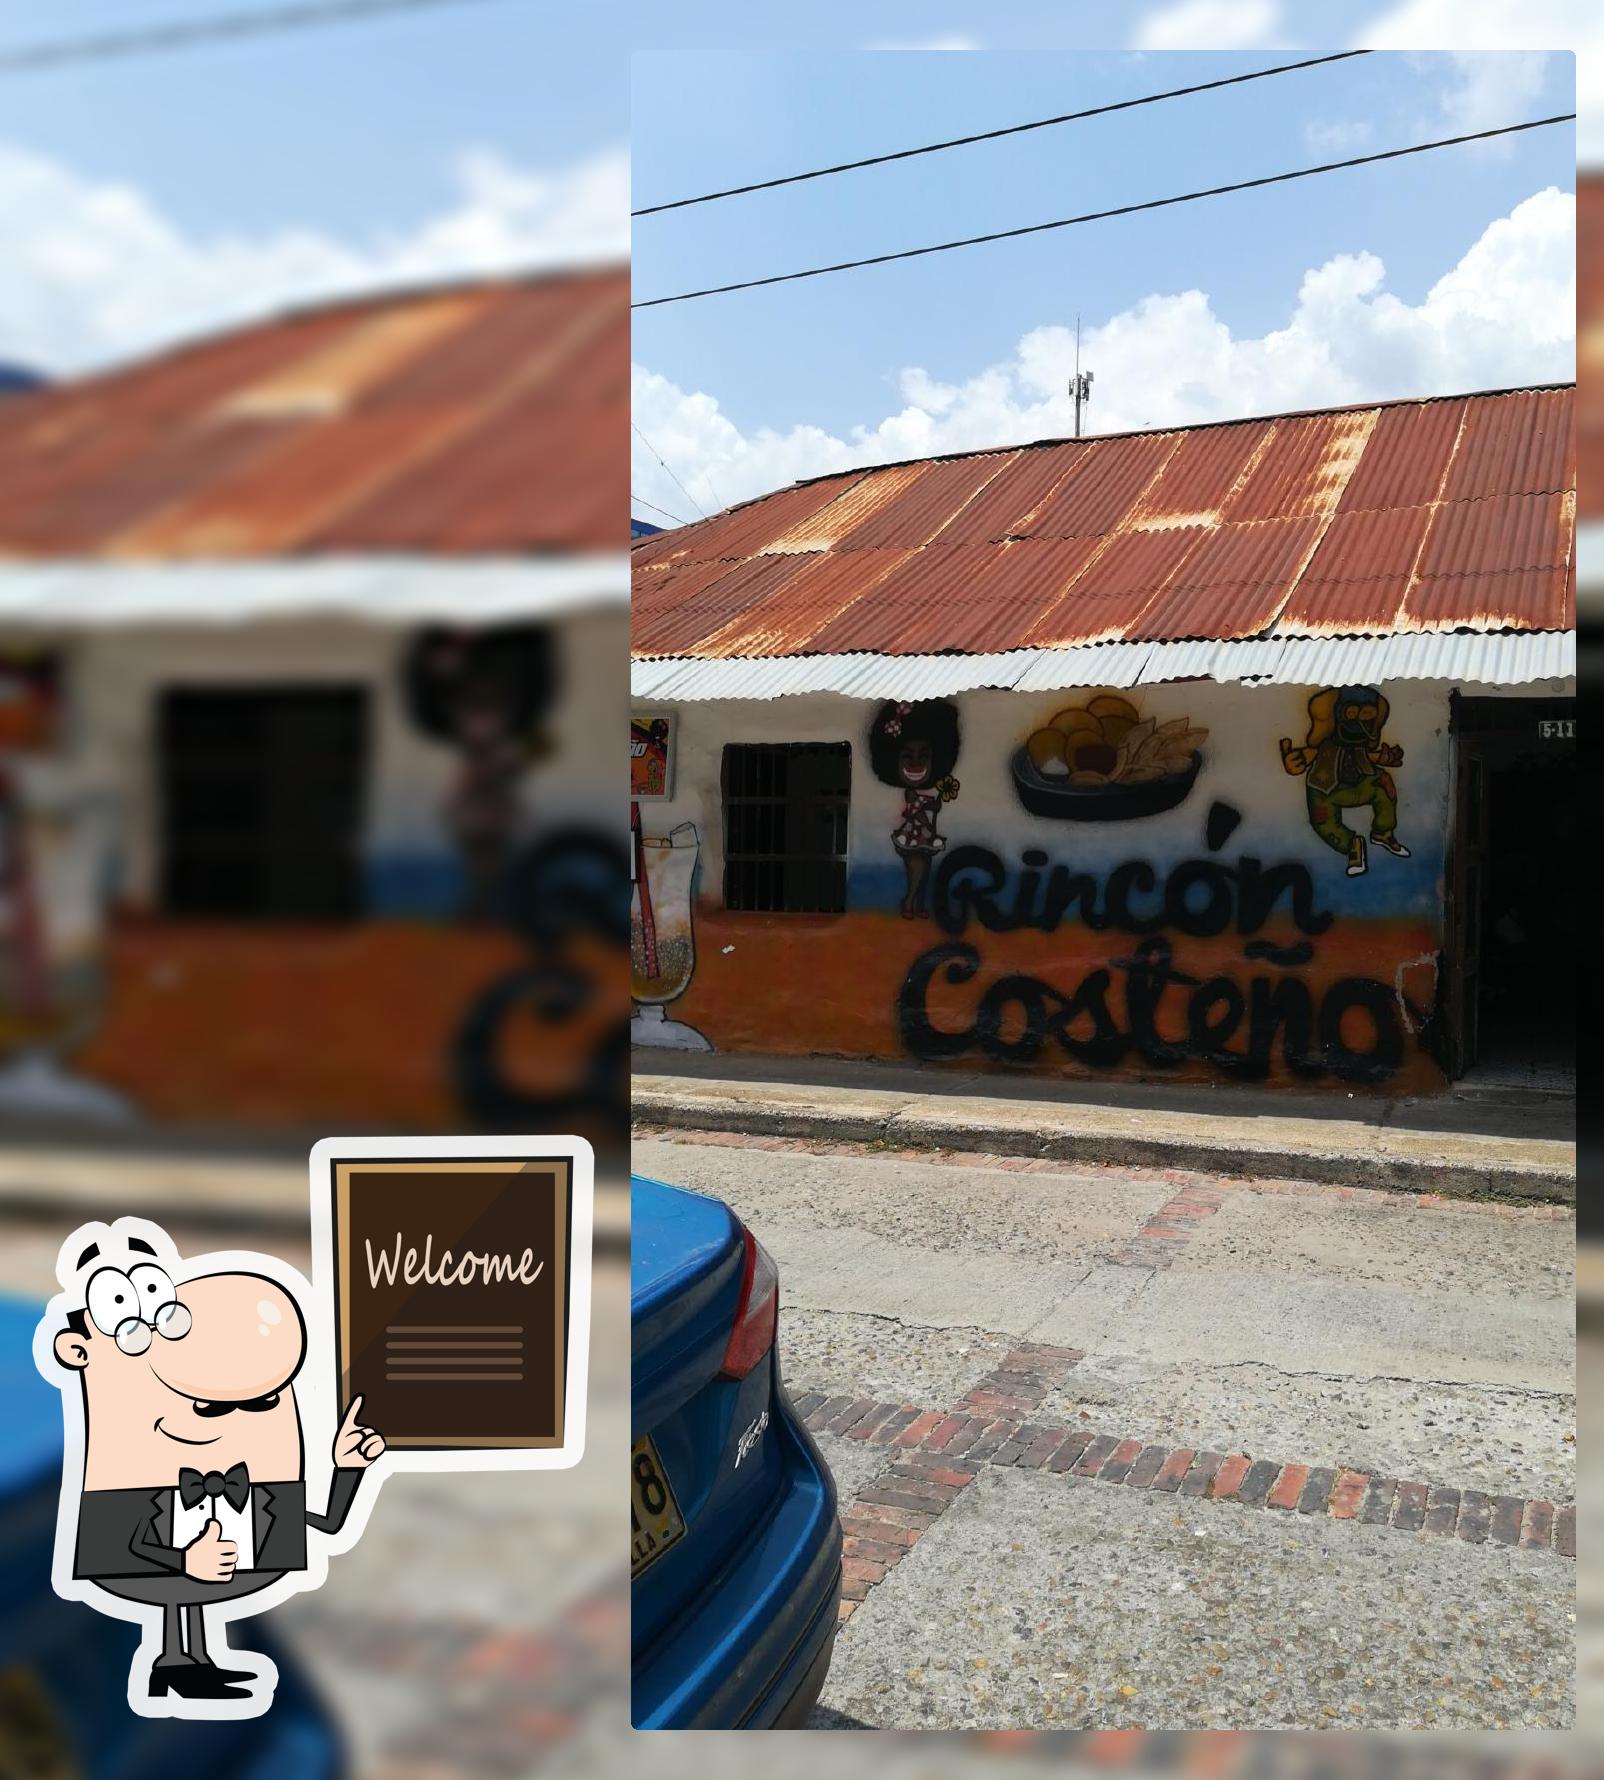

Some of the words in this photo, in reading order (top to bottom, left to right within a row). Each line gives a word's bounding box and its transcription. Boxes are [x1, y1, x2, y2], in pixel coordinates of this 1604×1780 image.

[934, 801, 1334, 936] Rincón
[900, 938, 1408, 1083] Costeño
[631, 1453, 667, 1532] 8
